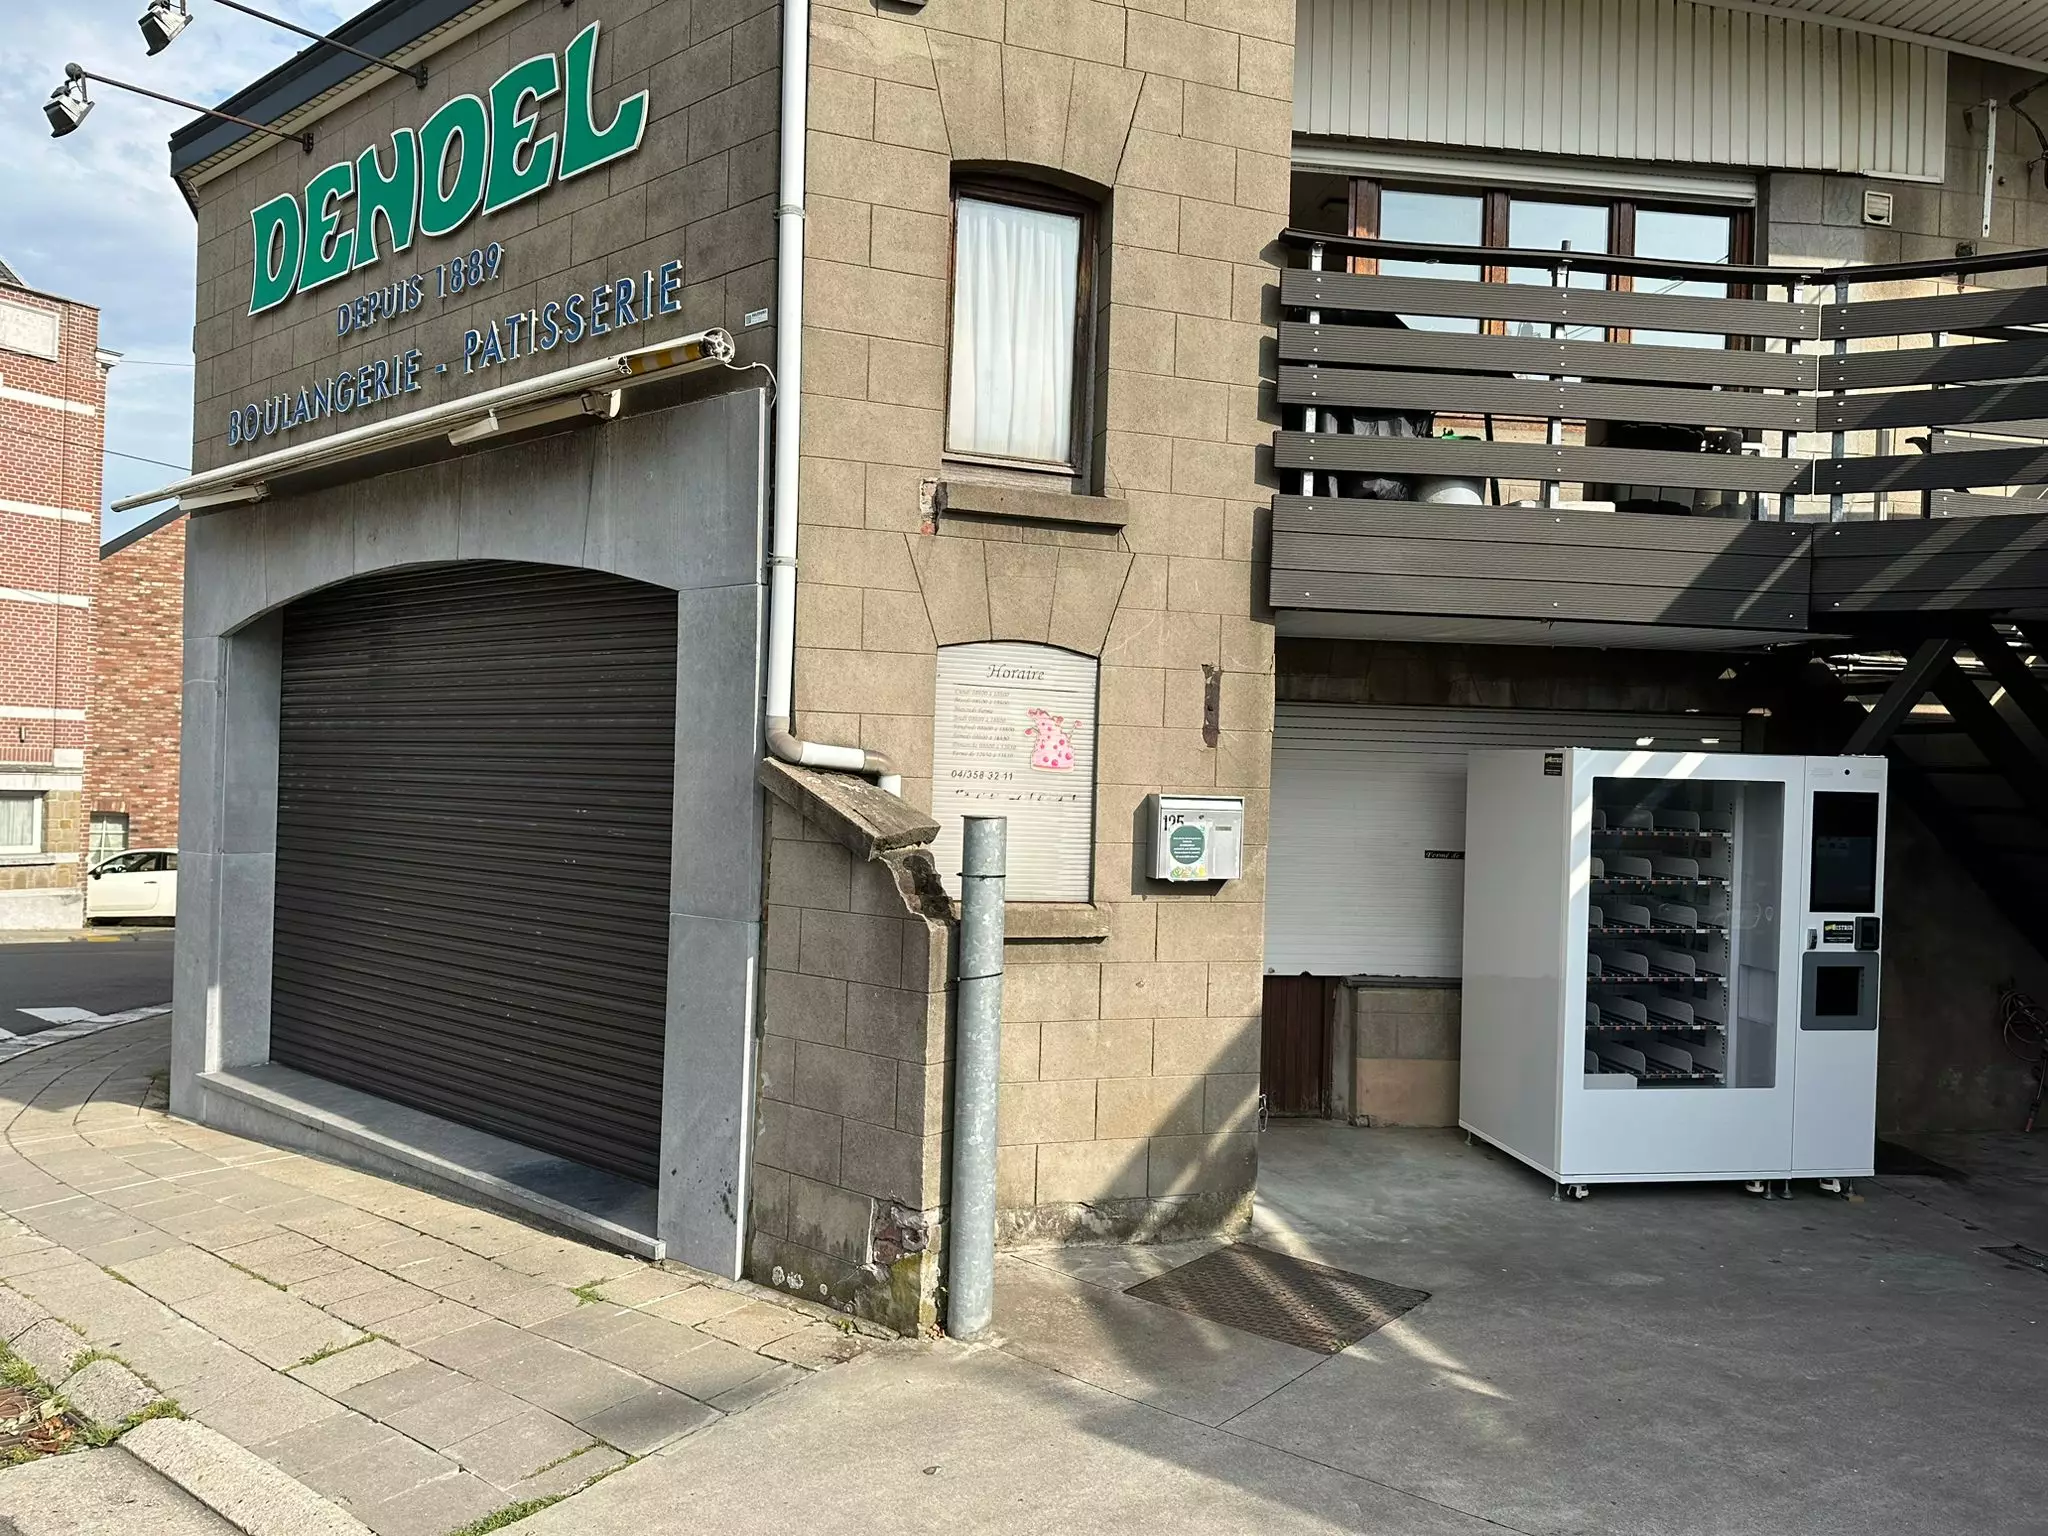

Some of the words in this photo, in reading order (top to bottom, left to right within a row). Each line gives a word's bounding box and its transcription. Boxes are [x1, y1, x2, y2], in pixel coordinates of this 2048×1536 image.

[247, 19, 649, 316] DENOEL
[337, 273, 424, 337] DEPUIS
[435, 241, 504, 298] 1889
[227, 349, 423, 447] BOULANGERIE
[463, 260, 683, 374] PATISSERIE
[987, 663, 1046, 681] Horaire
[951, 769, 984, 779] 04/358
[987, 771, 999, 780] 32
[1003, 772, 1013, 780] 11
